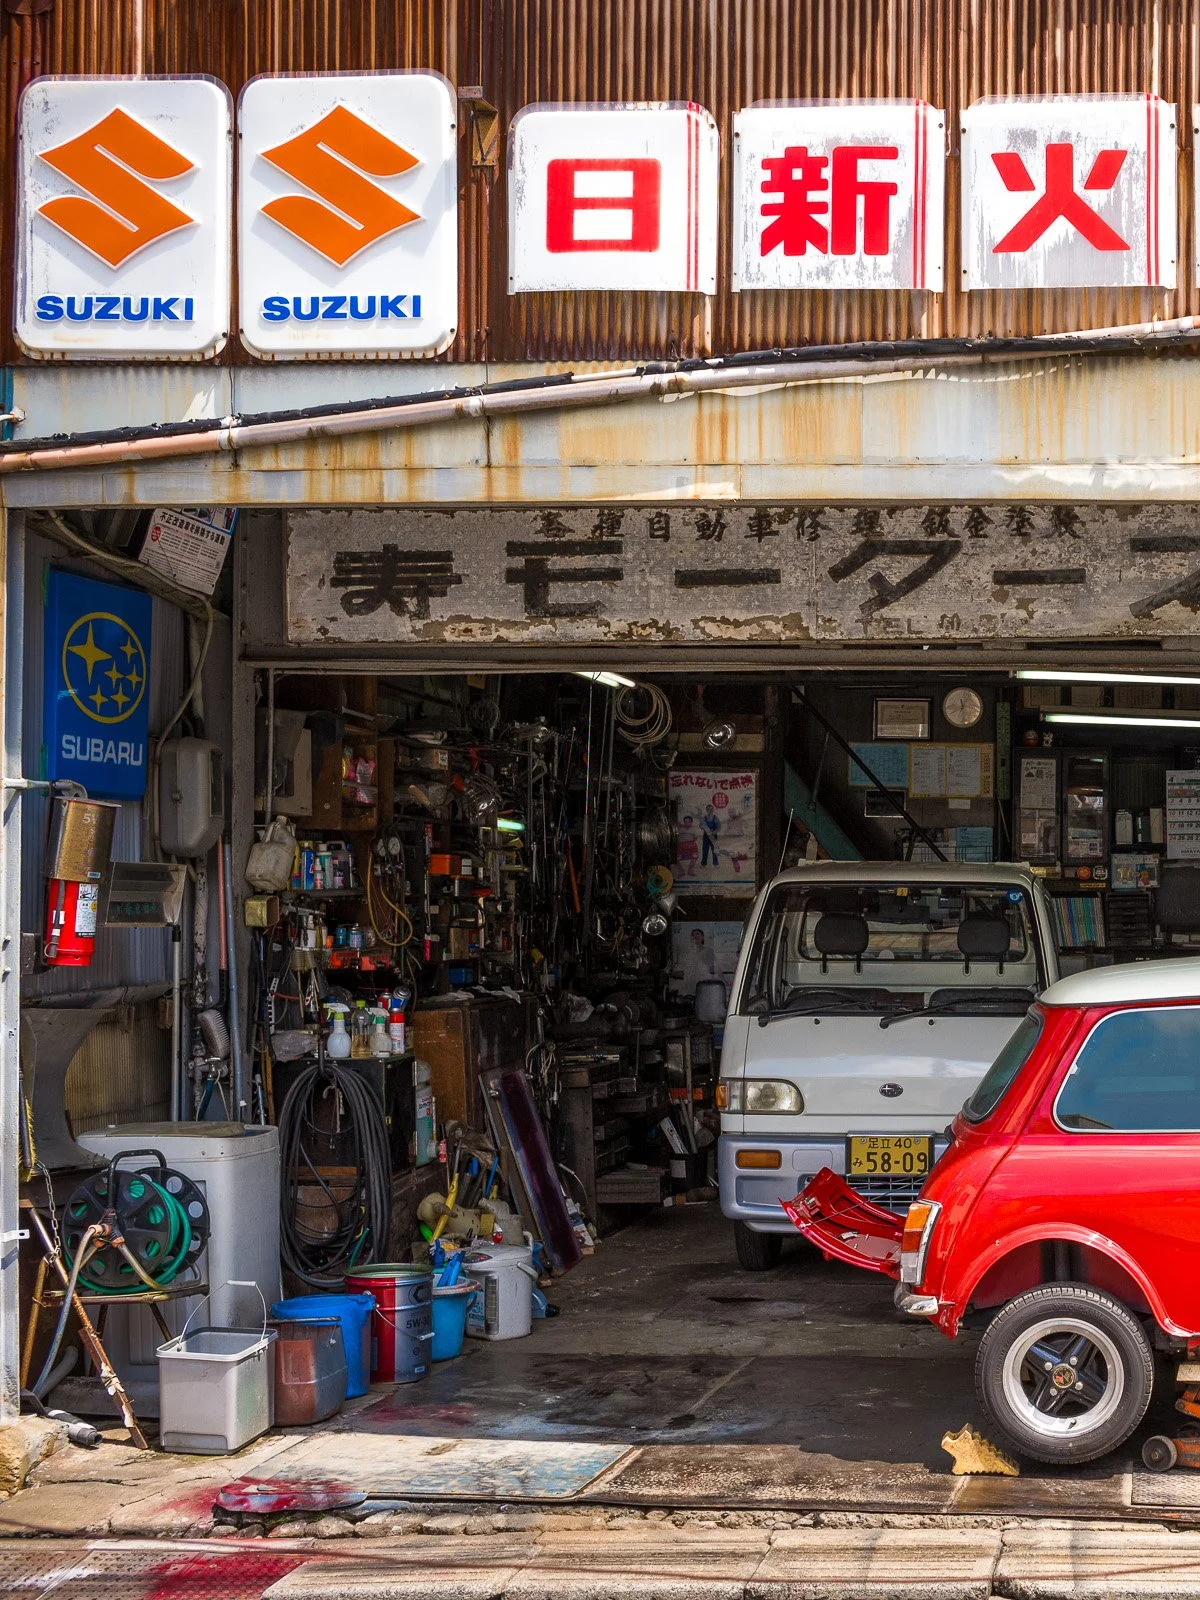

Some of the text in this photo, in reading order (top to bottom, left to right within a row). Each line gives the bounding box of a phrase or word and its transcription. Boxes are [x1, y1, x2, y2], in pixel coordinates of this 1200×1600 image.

[36, 296, 193, 322] SUZUKI
[262, 295, 421, 322] SUZUKI
[62, 734, 143, 766] SUBARU
[868, 1138, 912, 1149] 足立 40
[853, 1152, 928, 1173] み 58-09
